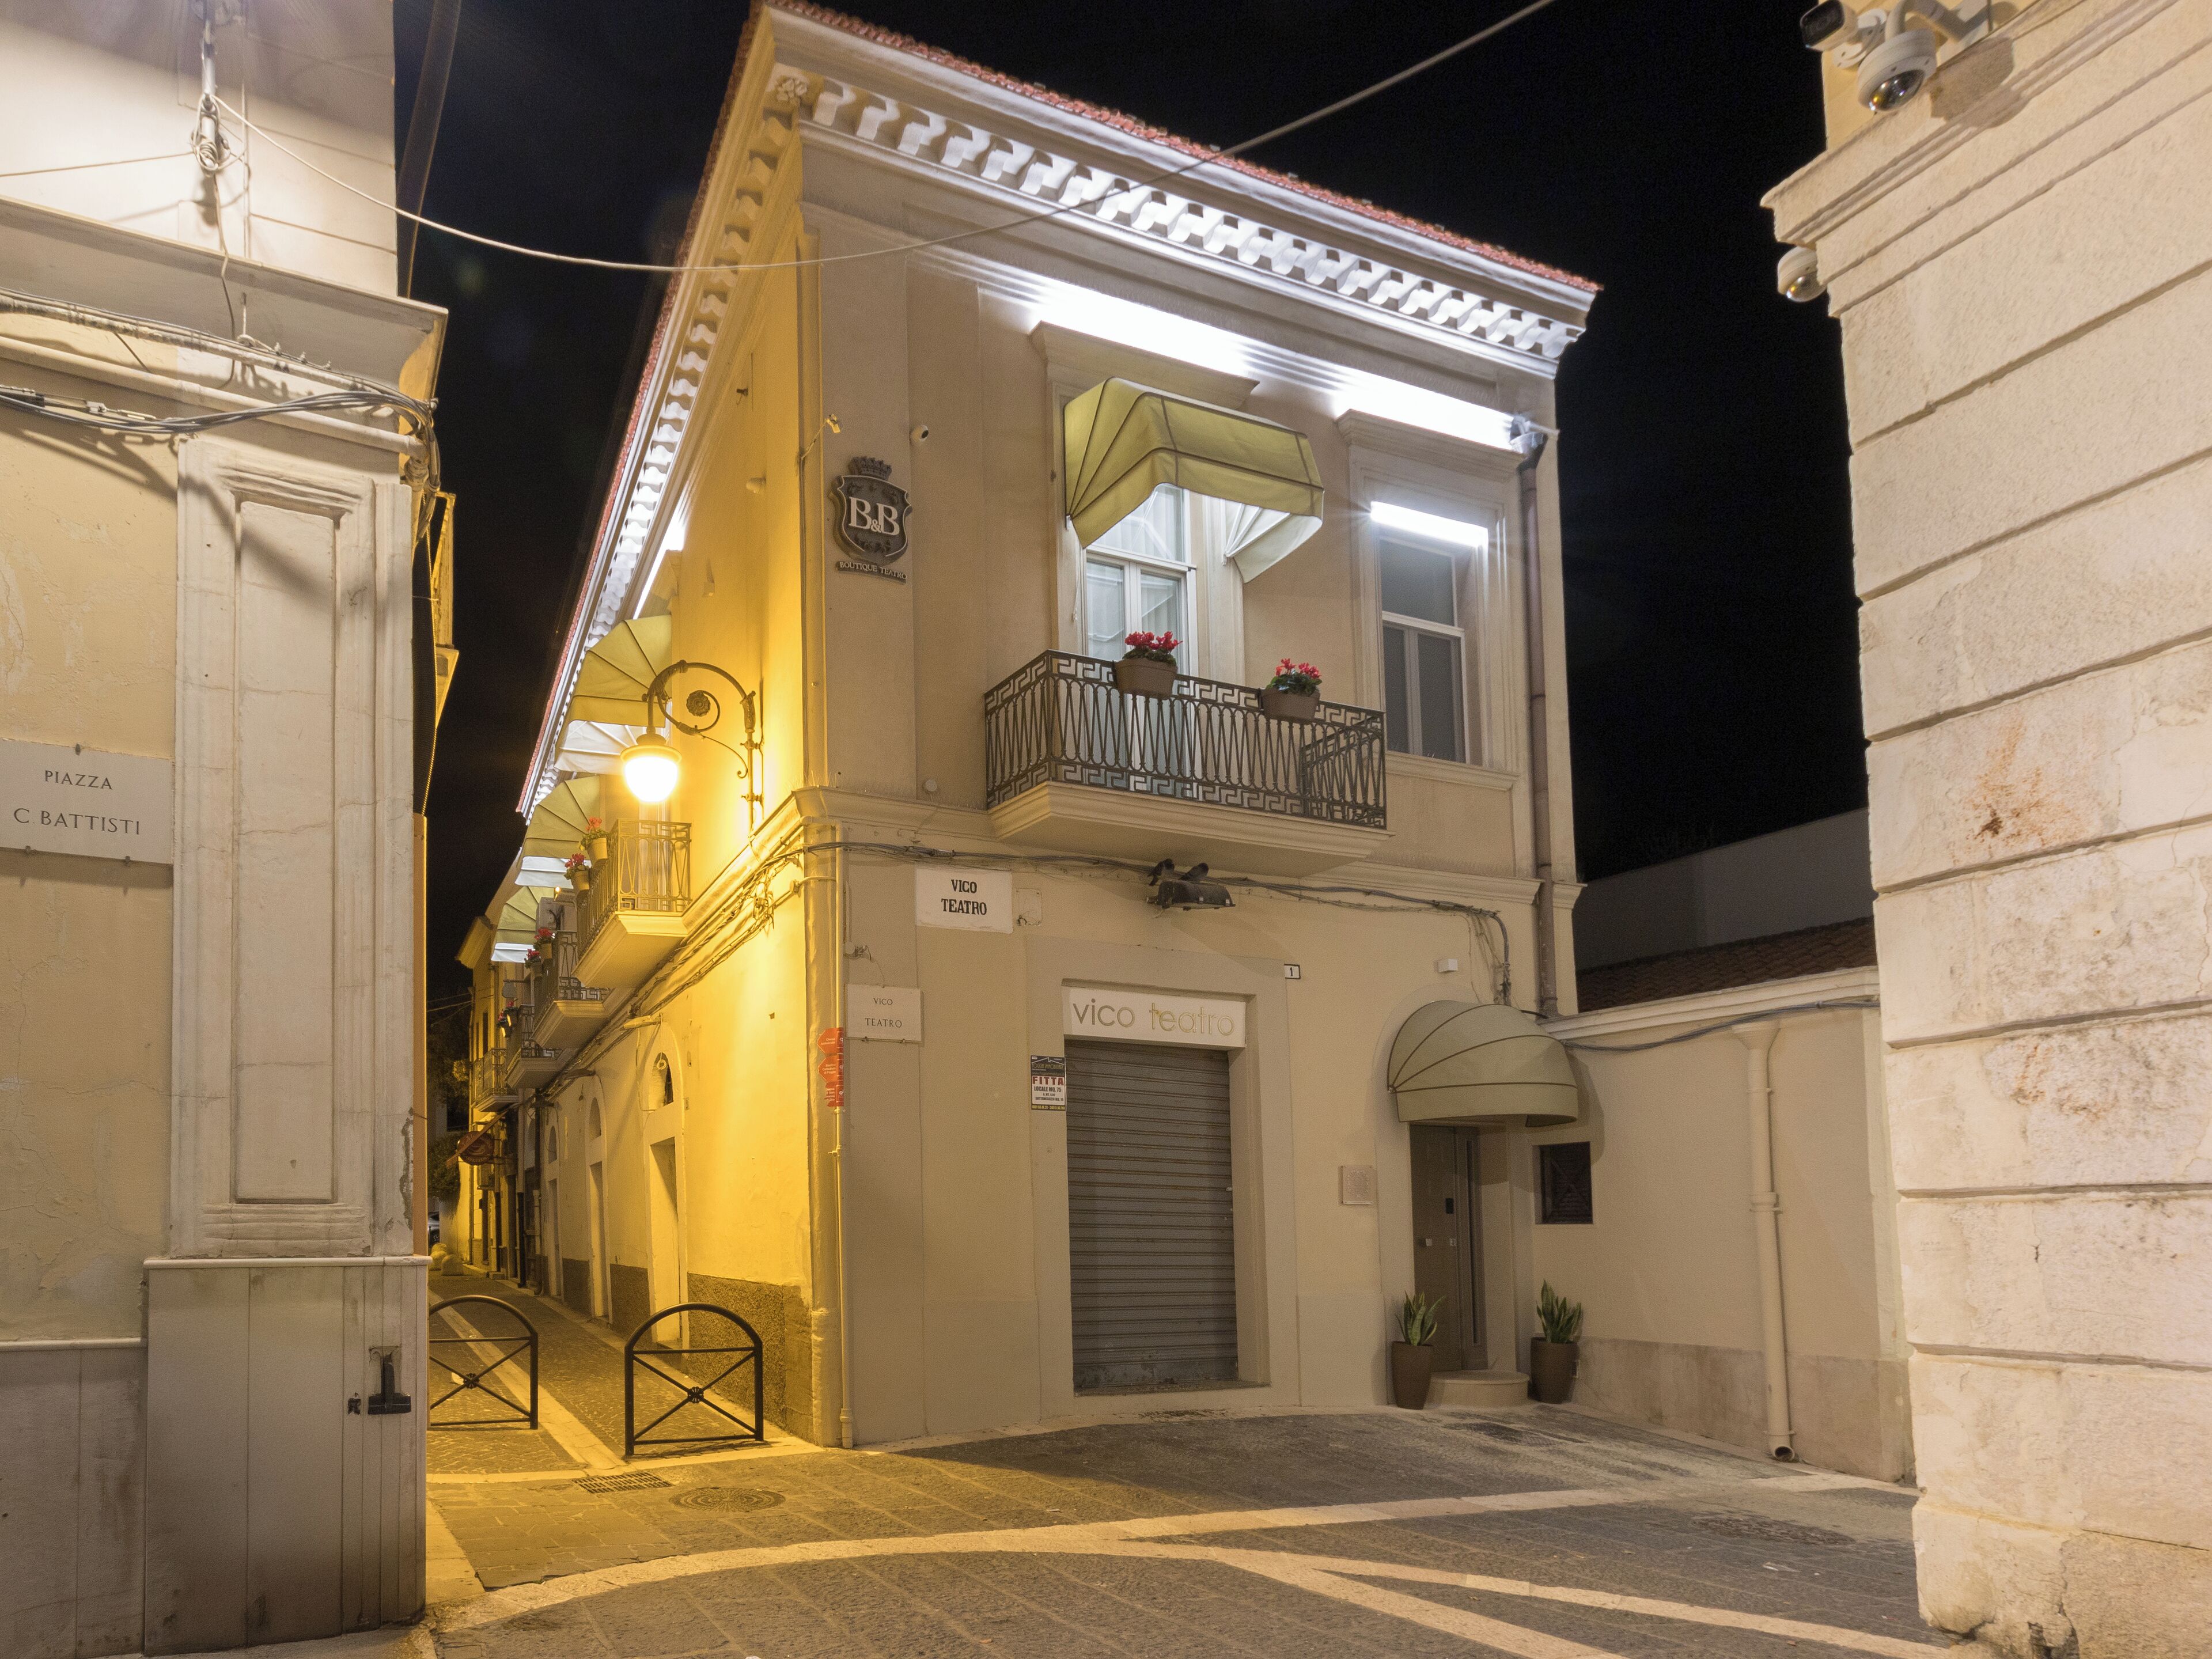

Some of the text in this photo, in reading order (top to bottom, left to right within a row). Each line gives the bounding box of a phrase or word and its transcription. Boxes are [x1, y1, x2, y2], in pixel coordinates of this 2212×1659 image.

[849, 497, 900, 536] B&B
[839, 561, 907, 579] BOUTIQUE TEATRO
[45, 770, 113, 790] PIAZZA
[40, 810, 139, 835] BATTISTI
[951, 879, 978, 893] VICO
[941, 898, 987, 915] TEATRO
[1290, 967, 1293, 976] 1
[873, 998, 893, 1006] VICO
[865, 1017, 902, 1028] TEATRO
[1073, 998, 1234, 1036] vico teatro
[1032, 1077, 1064, 1085] FITTA
